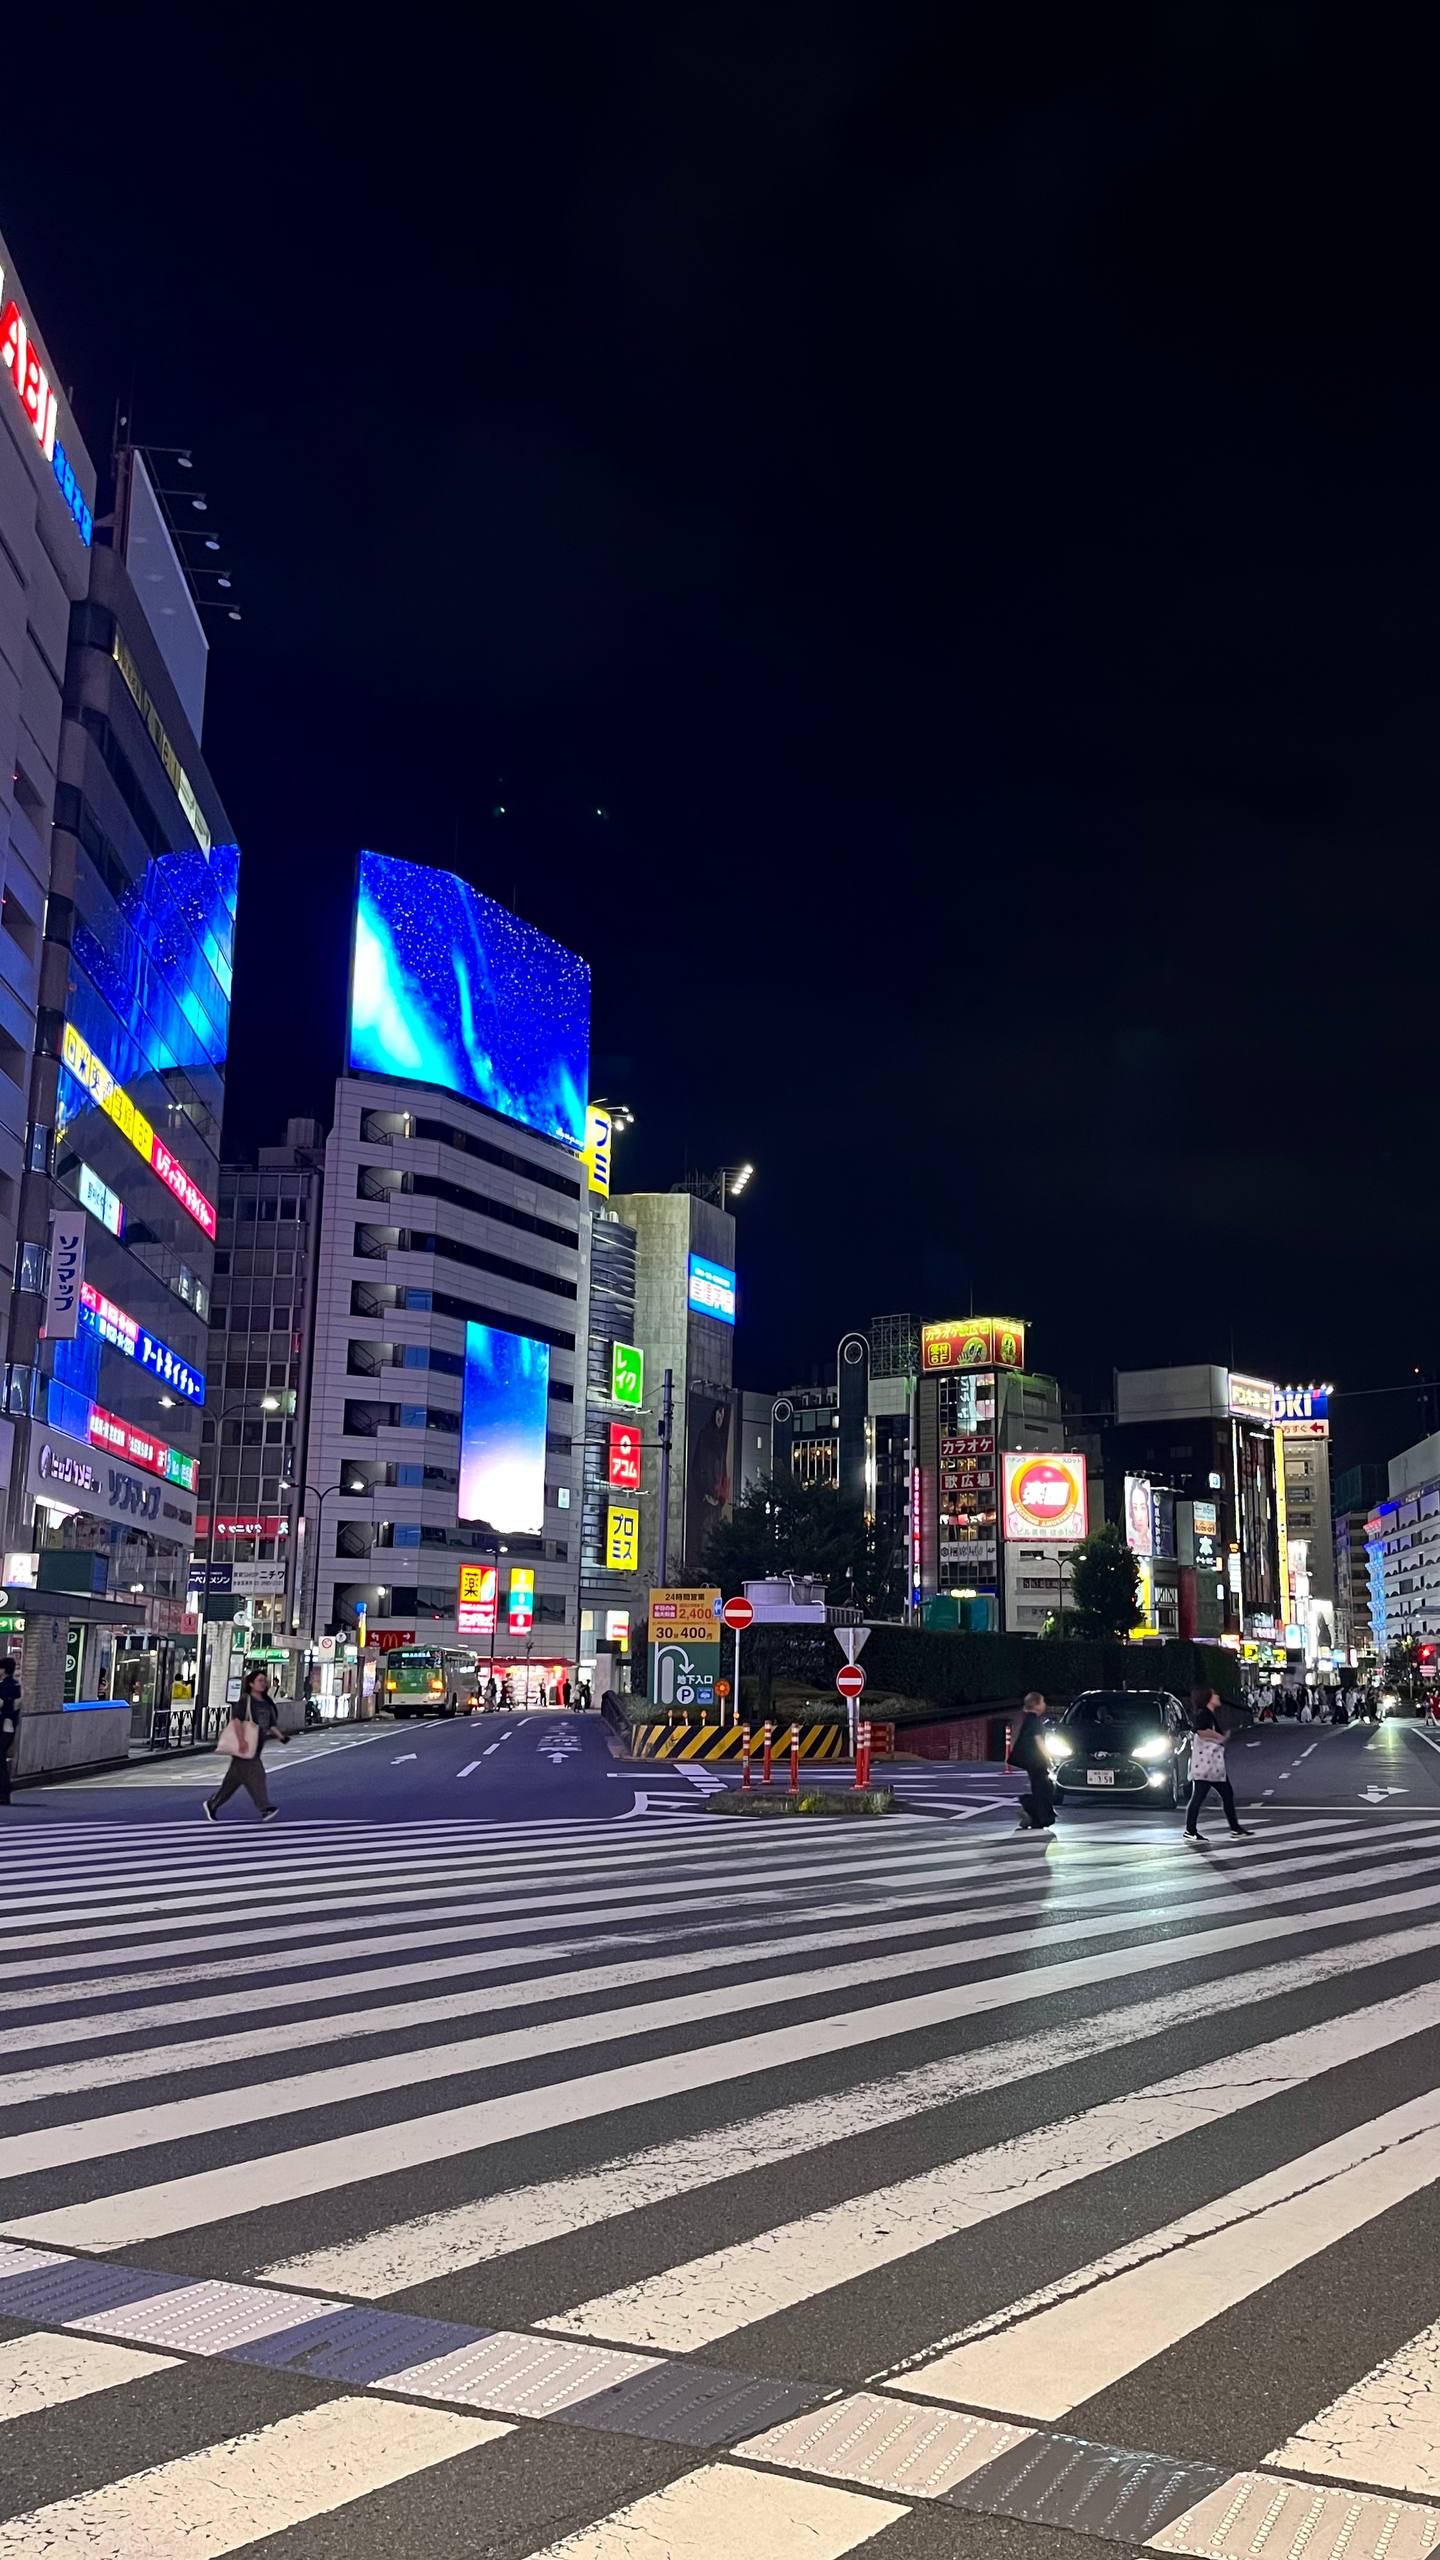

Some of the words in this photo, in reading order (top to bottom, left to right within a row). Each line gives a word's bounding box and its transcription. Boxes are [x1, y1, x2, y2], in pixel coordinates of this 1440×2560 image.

[56, 1235, 79, 1312] ソフマップ
[142, 1336, 201, 1396] アートネイチャー
[617, 1350, 627, 1369] レ
[930, 1354, 949, 1364] 6F
[615, 1370, 637, 1392] イク
[943, 1439, 992, 1454] カラオケ
[612, 1458, 637, 1479] アコム
[944, 1472, 991, 1488] 歌広場
[108, 1469, 161, 1520] ソフマップ
[613, 1513, 634, 1537] プロ
[613, 1540, 633, 1560] ミス
[259, 1569, 285, 1580] ニチワ
[464, 1572, 479, 1597] 薬
[679, 1608, 712, 1621] 2,400
[676, 1675, 713, 1685] 地下入口
[681, 1688, 691, 1702] P
